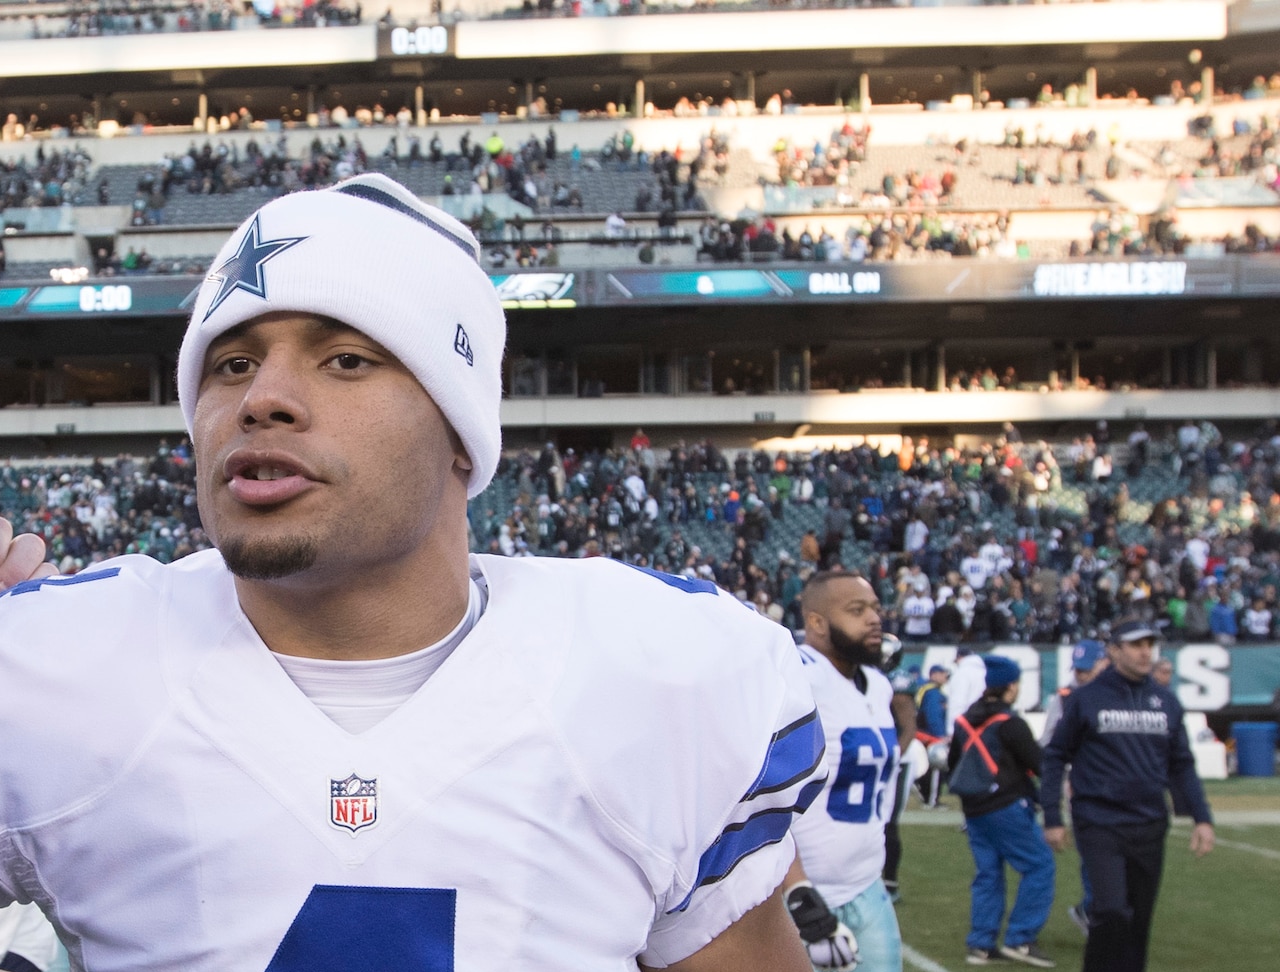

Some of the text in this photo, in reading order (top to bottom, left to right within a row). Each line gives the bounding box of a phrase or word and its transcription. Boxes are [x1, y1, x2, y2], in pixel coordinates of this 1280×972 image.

[391, 26, 448, 55] 0:00
[809, 272, 881, 294] BALL ON
[79, 285, 132, 311] 0:00
[1097, 709, 1169, 731] COWBOYS
[335, 799, 373, 825] NFL
